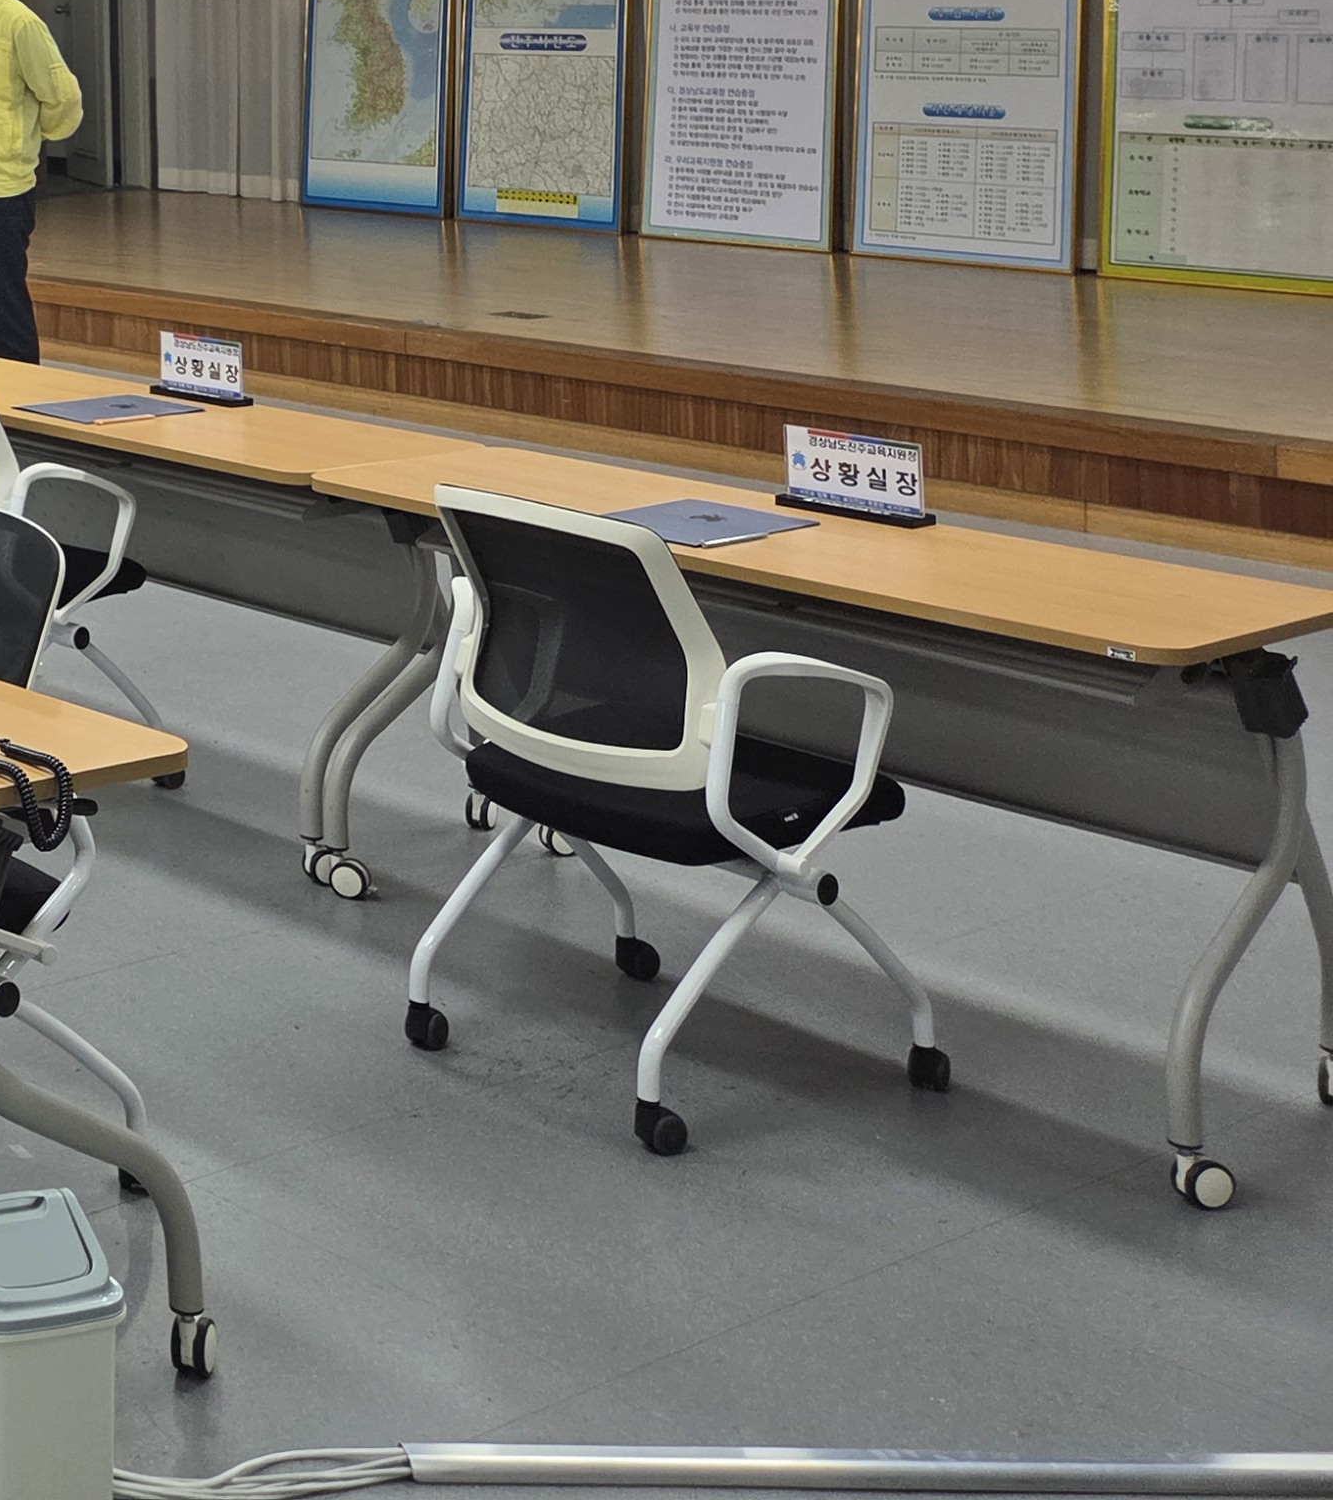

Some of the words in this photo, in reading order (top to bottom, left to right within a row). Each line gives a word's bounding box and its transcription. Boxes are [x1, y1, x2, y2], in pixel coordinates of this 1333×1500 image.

[174, 355, 239, 384] 상황실장
[808, 435, 917, 462] 경상남도진주교육지원청
[810, 457, 918, 497] 상황실장
